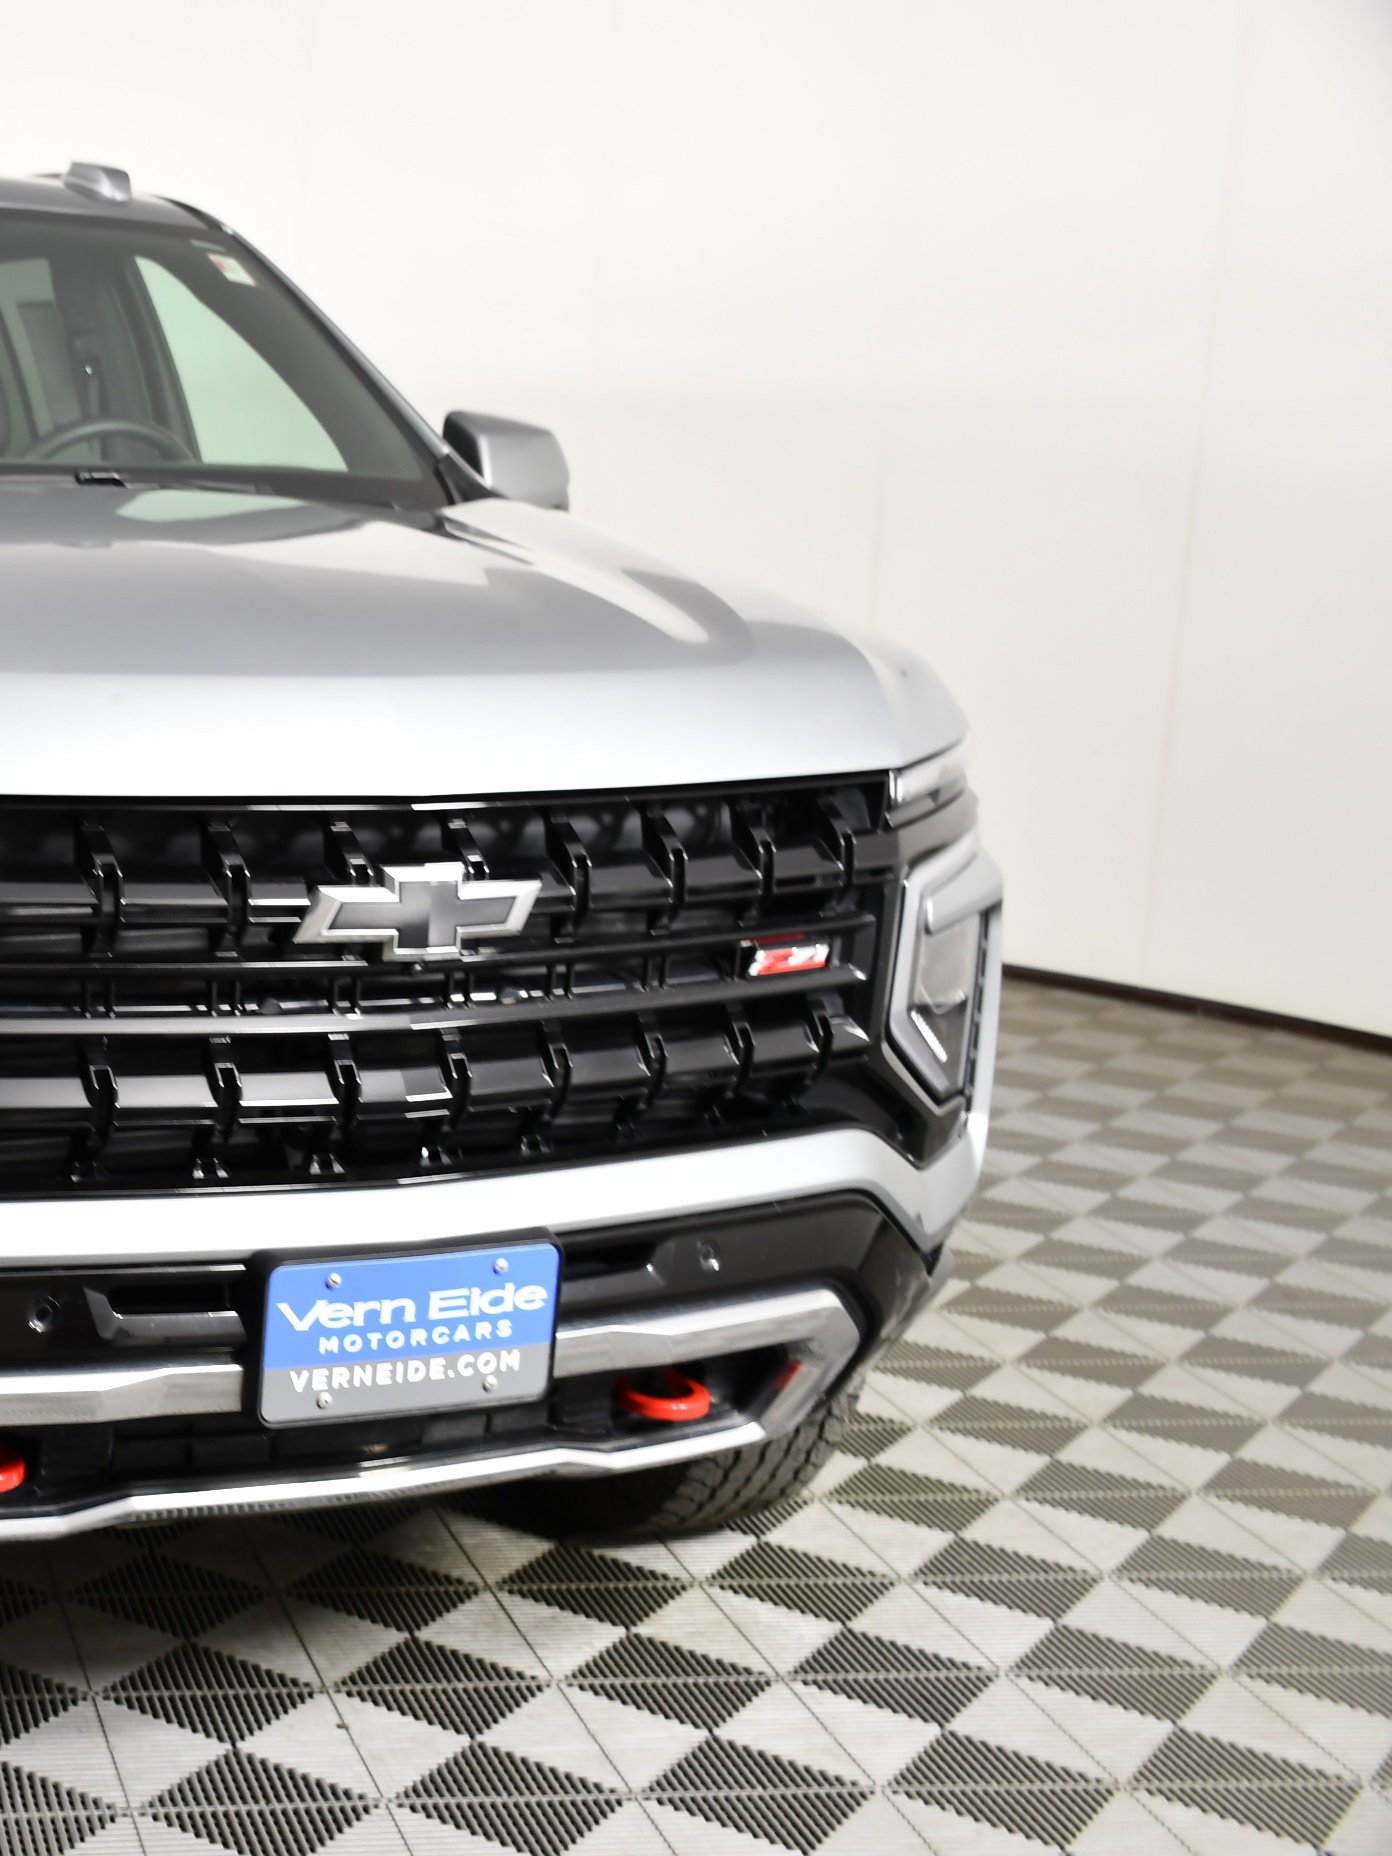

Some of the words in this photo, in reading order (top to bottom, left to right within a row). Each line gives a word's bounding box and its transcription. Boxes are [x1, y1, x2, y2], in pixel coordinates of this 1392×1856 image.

[276, 1298, 416, 1332] Vern
[428, 1282, 548, 1320] Eide
[318, 1319, 513, 1355] MOTORCARS
[289, 1349, 521, 1393] VERNEIDE.COM
